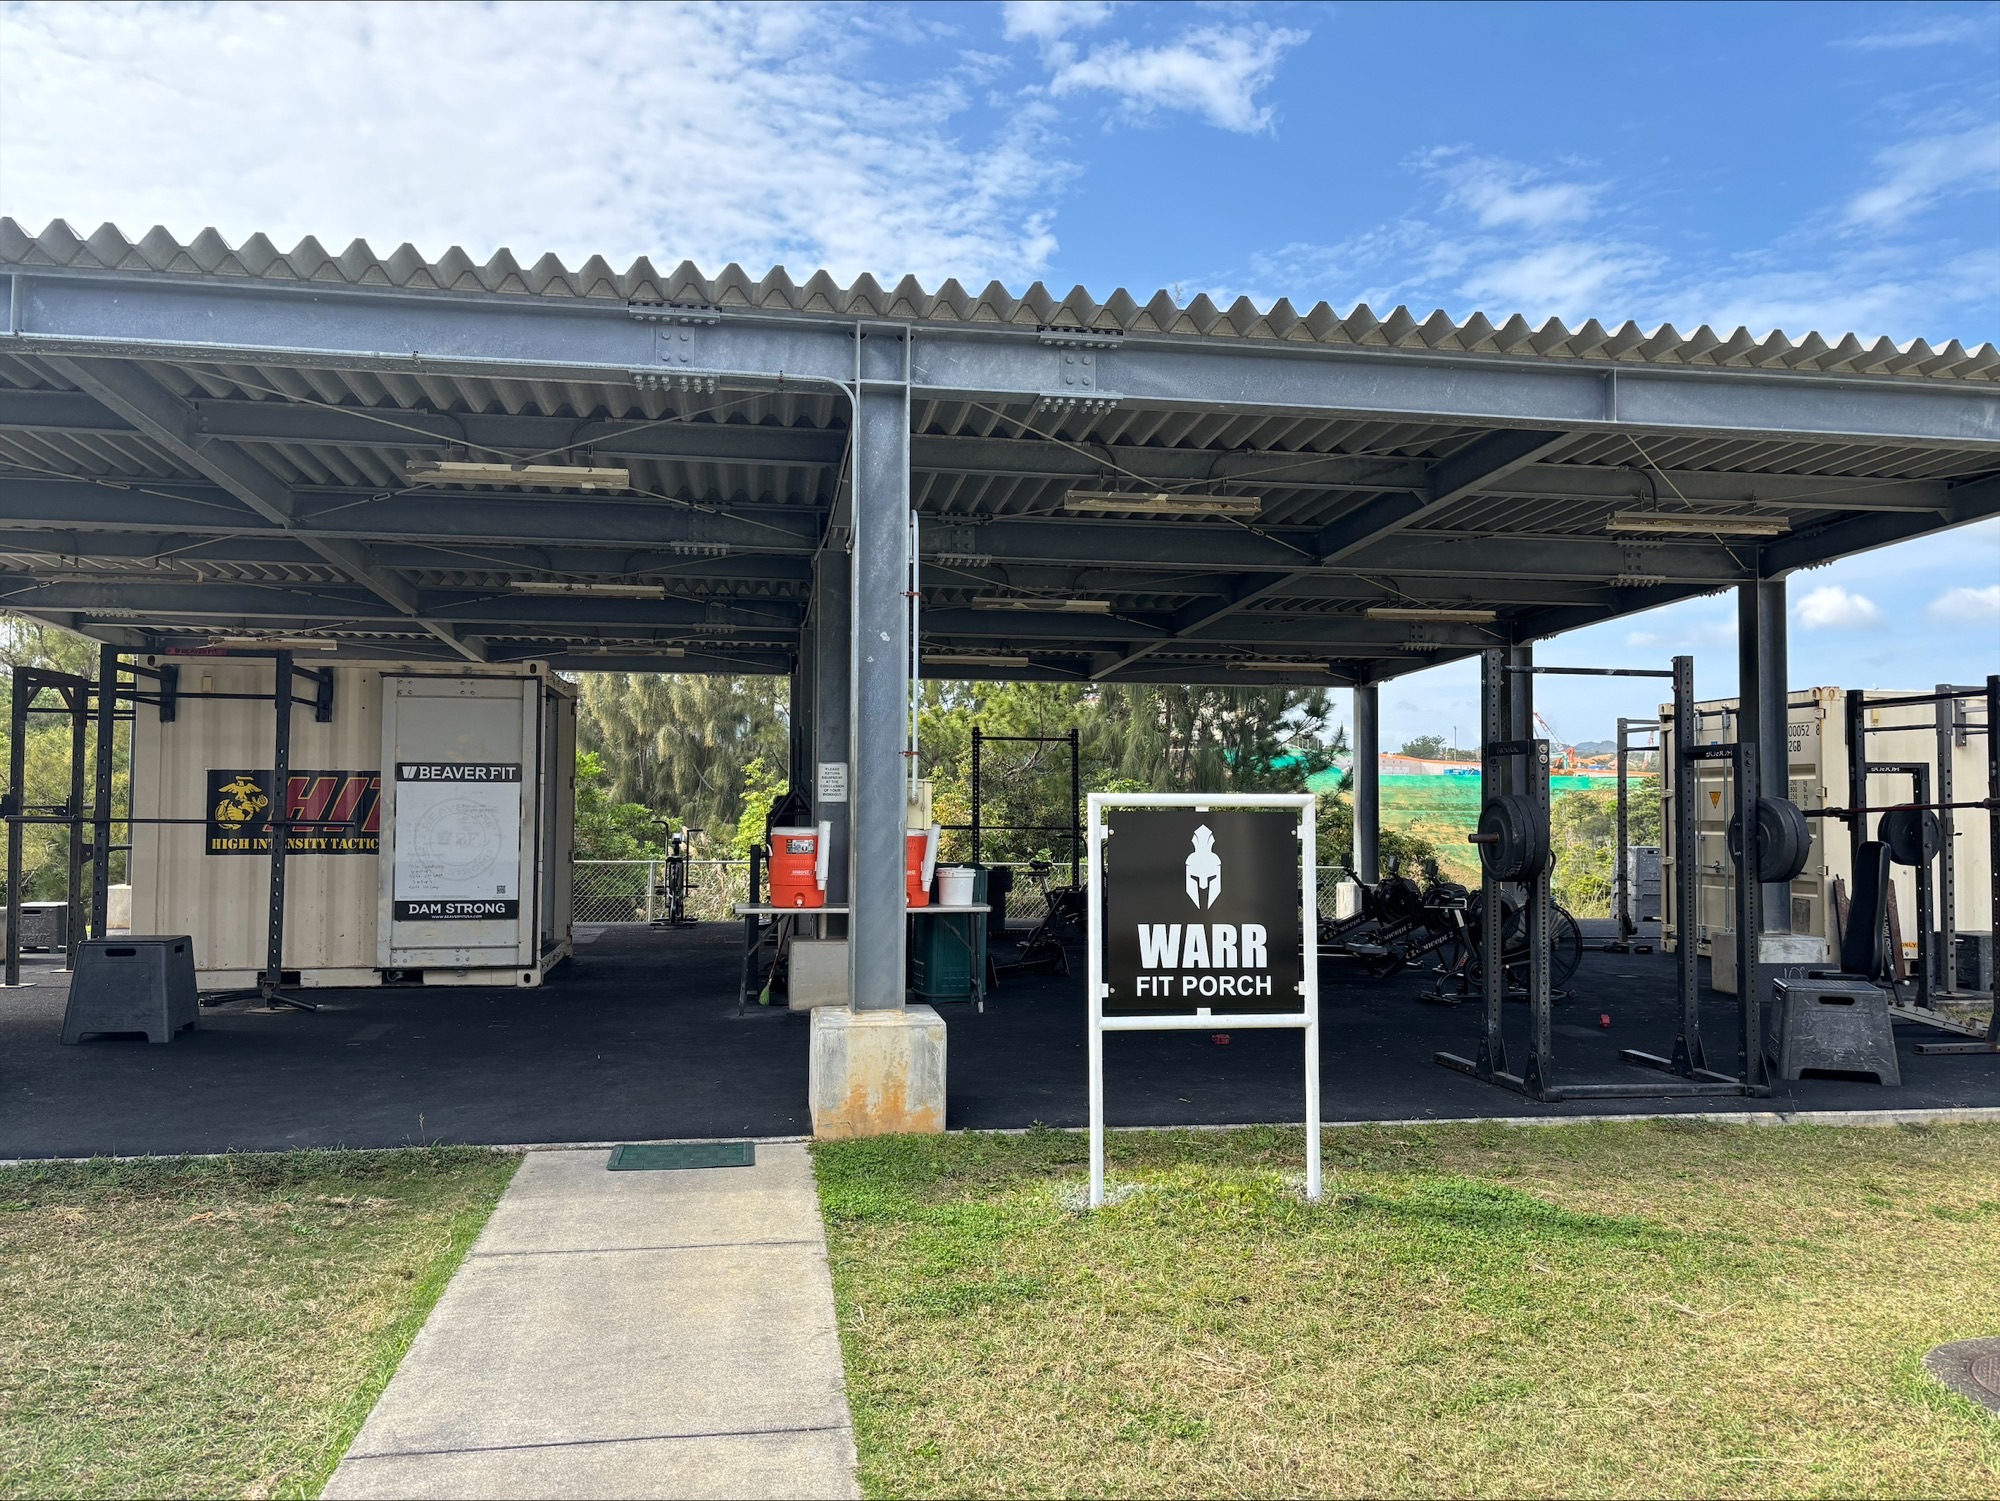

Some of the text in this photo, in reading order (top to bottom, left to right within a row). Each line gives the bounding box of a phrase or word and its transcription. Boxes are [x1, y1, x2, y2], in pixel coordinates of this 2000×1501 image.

[211, 838, 250, 850] HIGH
[253, 838, 329, 850] INTNSITY
[408, 902, 506, 915] DAM STRONG
[1137, 923, 1268, 969] WARR
[1136, 975, 1272, 997] FIT PORCH
